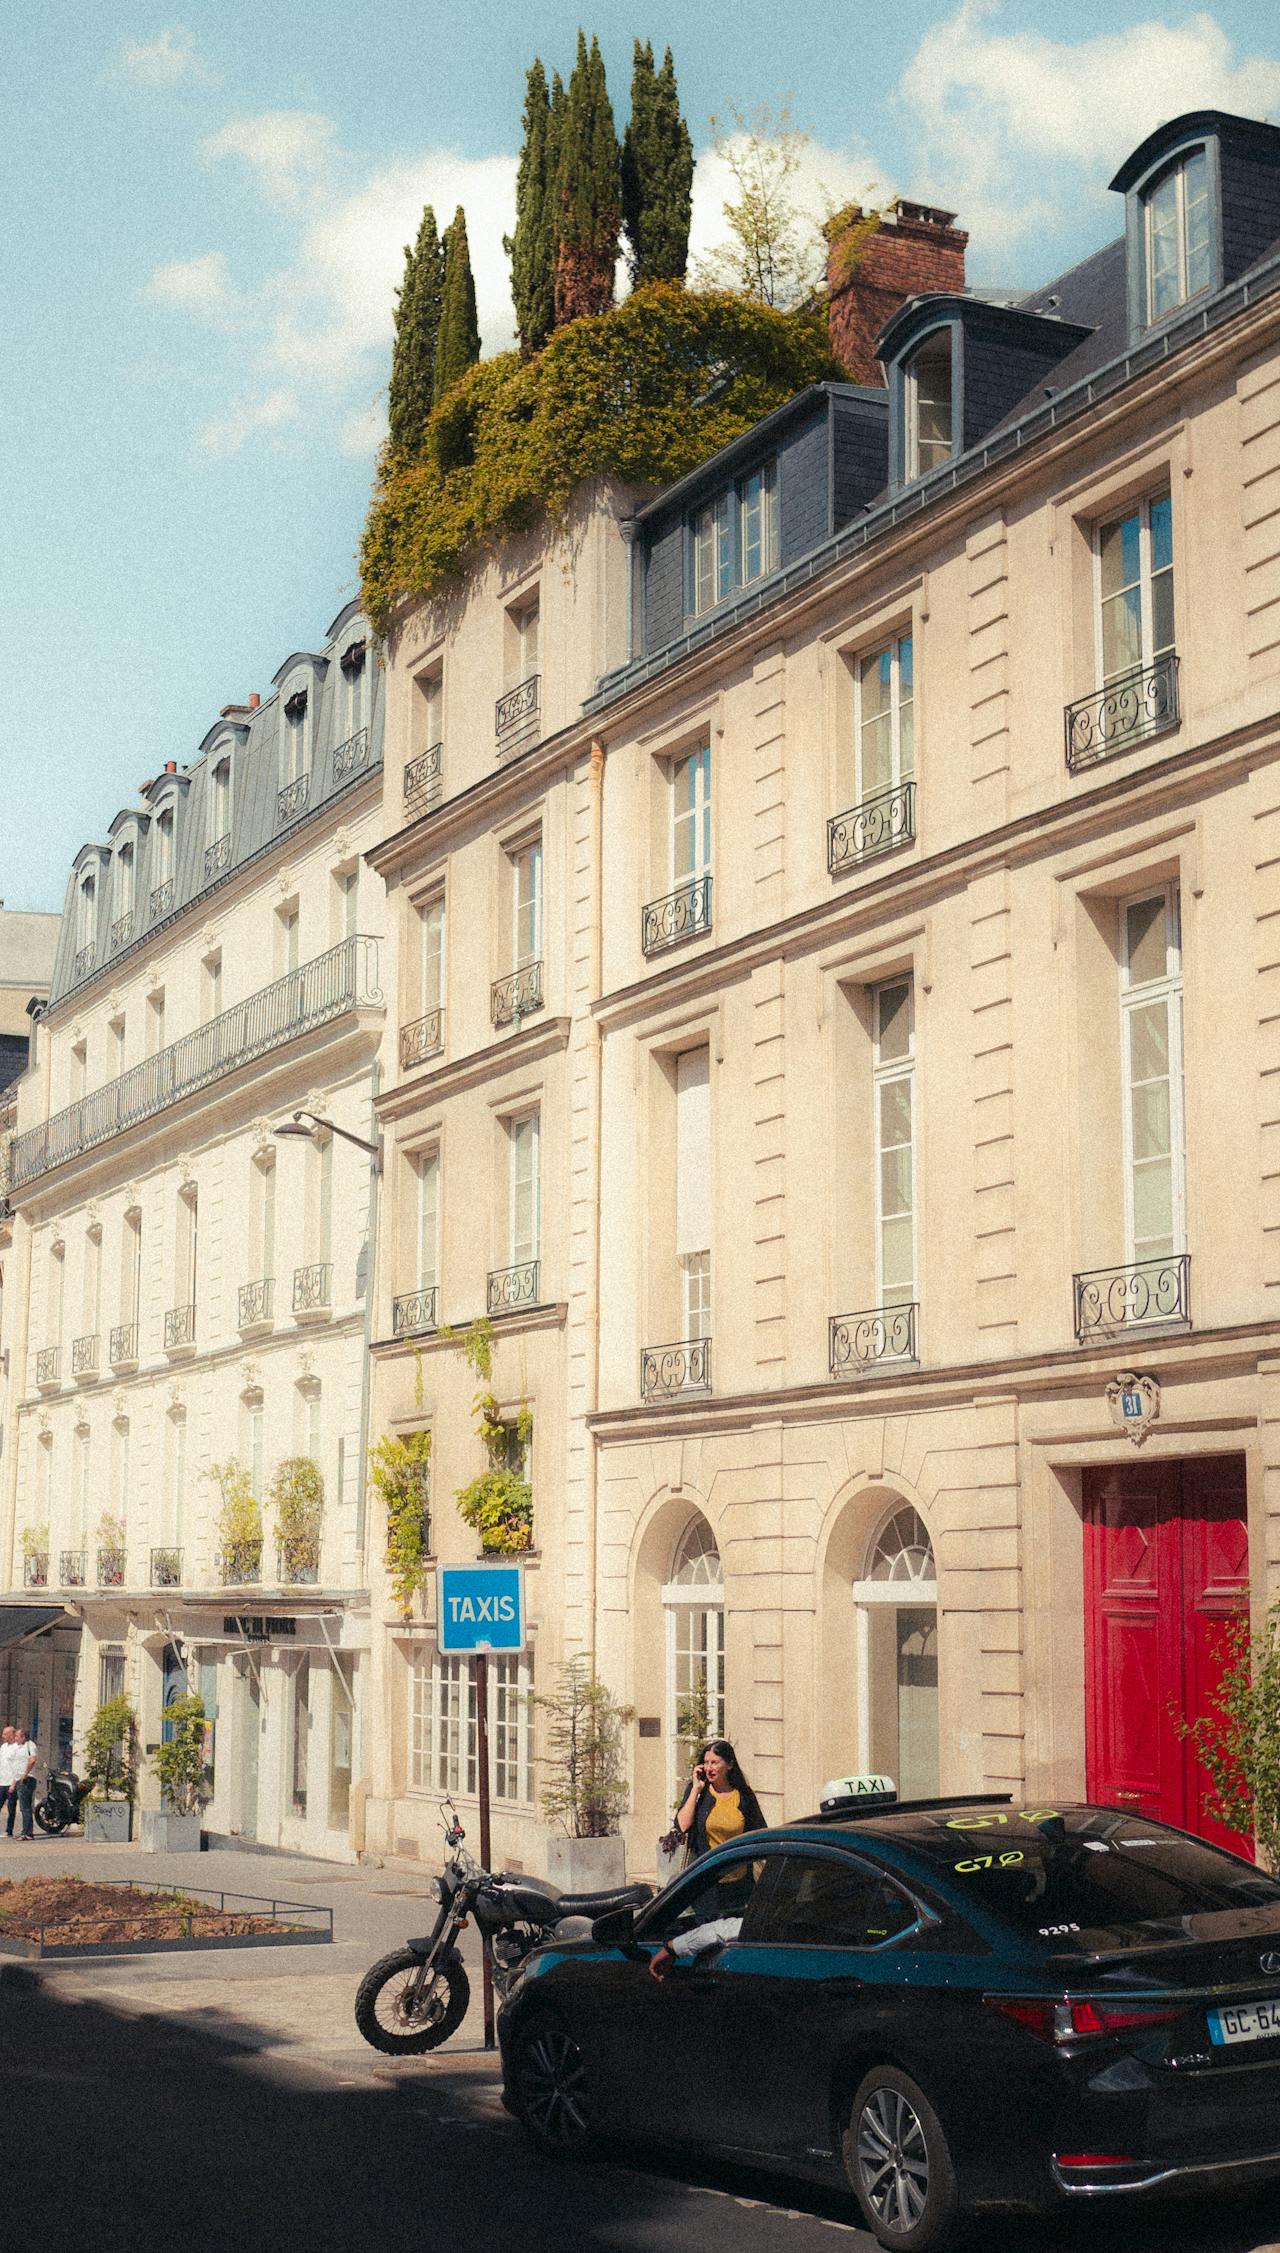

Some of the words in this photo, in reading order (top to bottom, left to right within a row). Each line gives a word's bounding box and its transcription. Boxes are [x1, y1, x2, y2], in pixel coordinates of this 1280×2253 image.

[1125, 1395, 1139, 1415] 31
[447, 1595, 515, 1622] TAXIS
[844, 1778, 886, 1793] TAXI
[945, 1813, 1008, 1830] G7
[954, 1855, 993, 1873] G7
[1038, 1922, 1080, 1936] 9295
